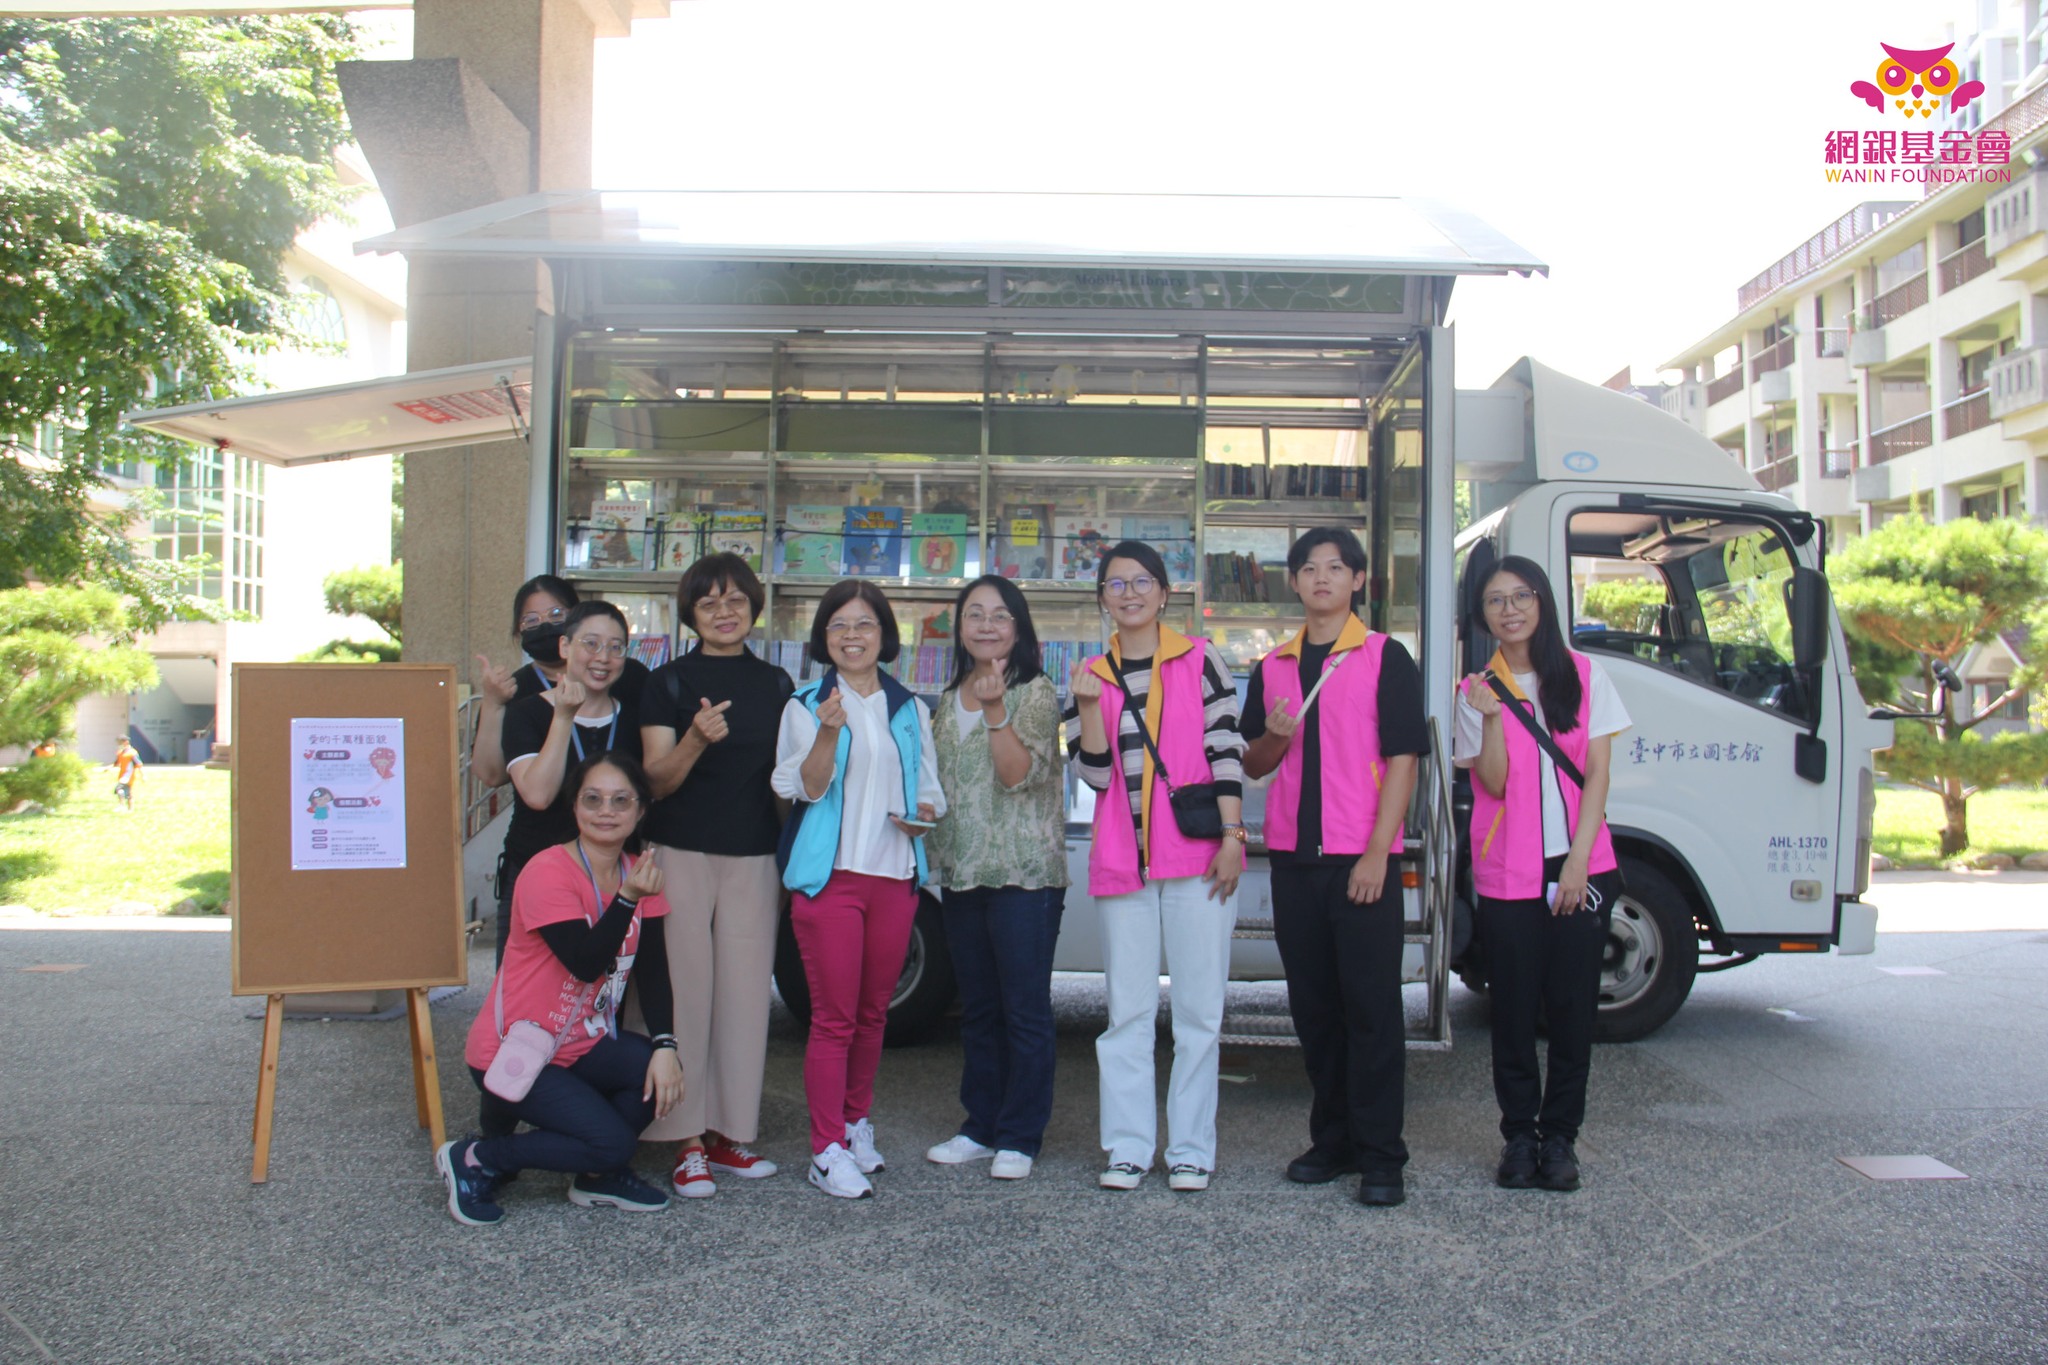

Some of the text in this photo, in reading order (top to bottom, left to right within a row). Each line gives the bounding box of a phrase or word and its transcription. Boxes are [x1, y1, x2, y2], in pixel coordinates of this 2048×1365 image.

[308, 733, 388, 746] 愛的千萬種面貌
[1768, 835, 1828, 849] AHL-1370
